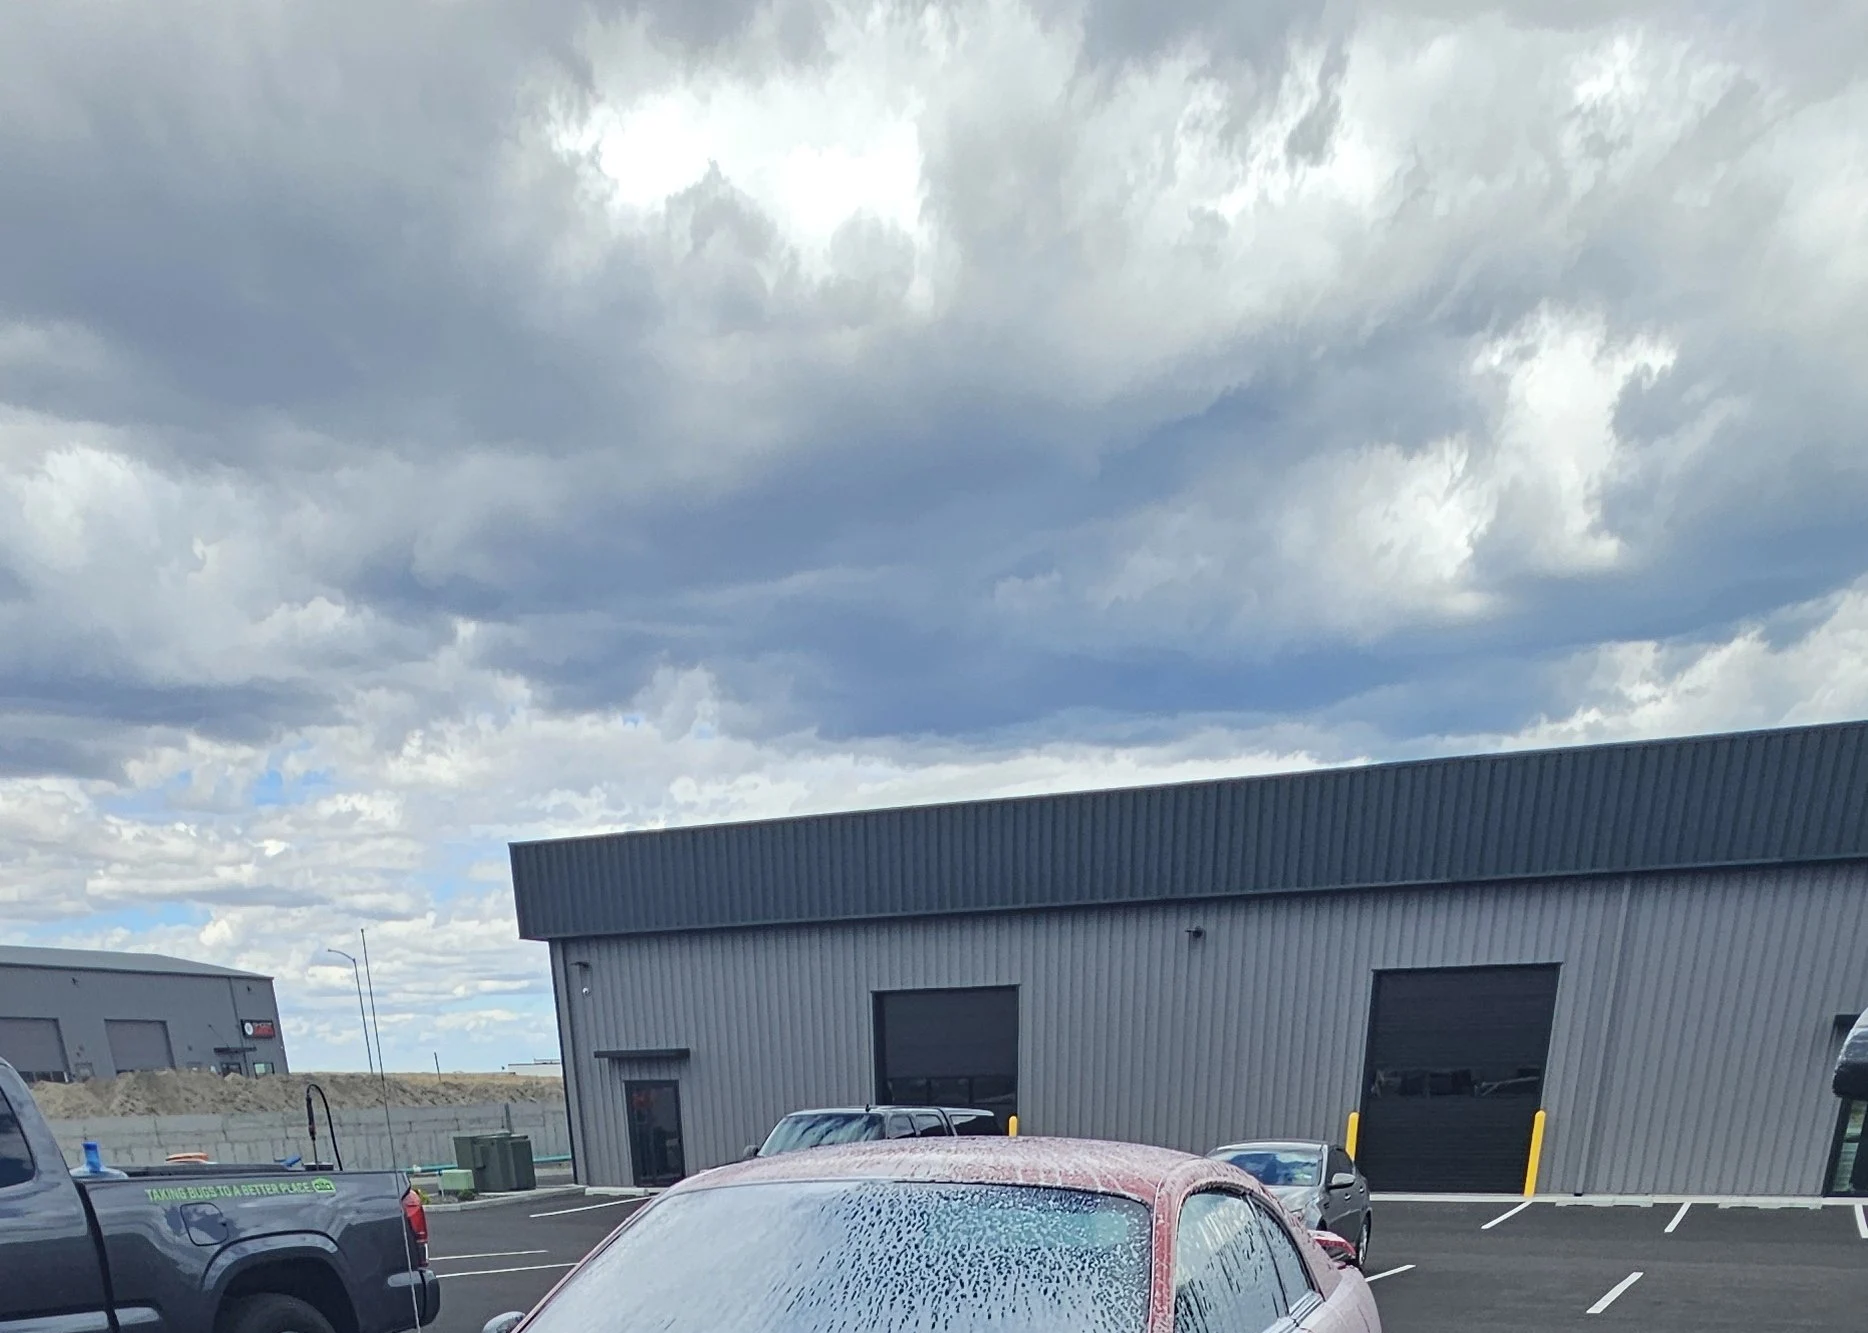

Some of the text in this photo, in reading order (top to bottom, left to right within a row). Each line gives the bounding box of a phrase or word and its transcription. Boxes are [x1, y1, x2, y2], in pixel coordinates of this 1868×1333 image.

[144, 1188, 187, 1201] TAKING
[187, 1187, 217, 1199] BUGS
[216, 1185, 232, 1197] TO
[232, 1185, 241, 1197] A
[241, 1184, 279, 1196] BETTER
